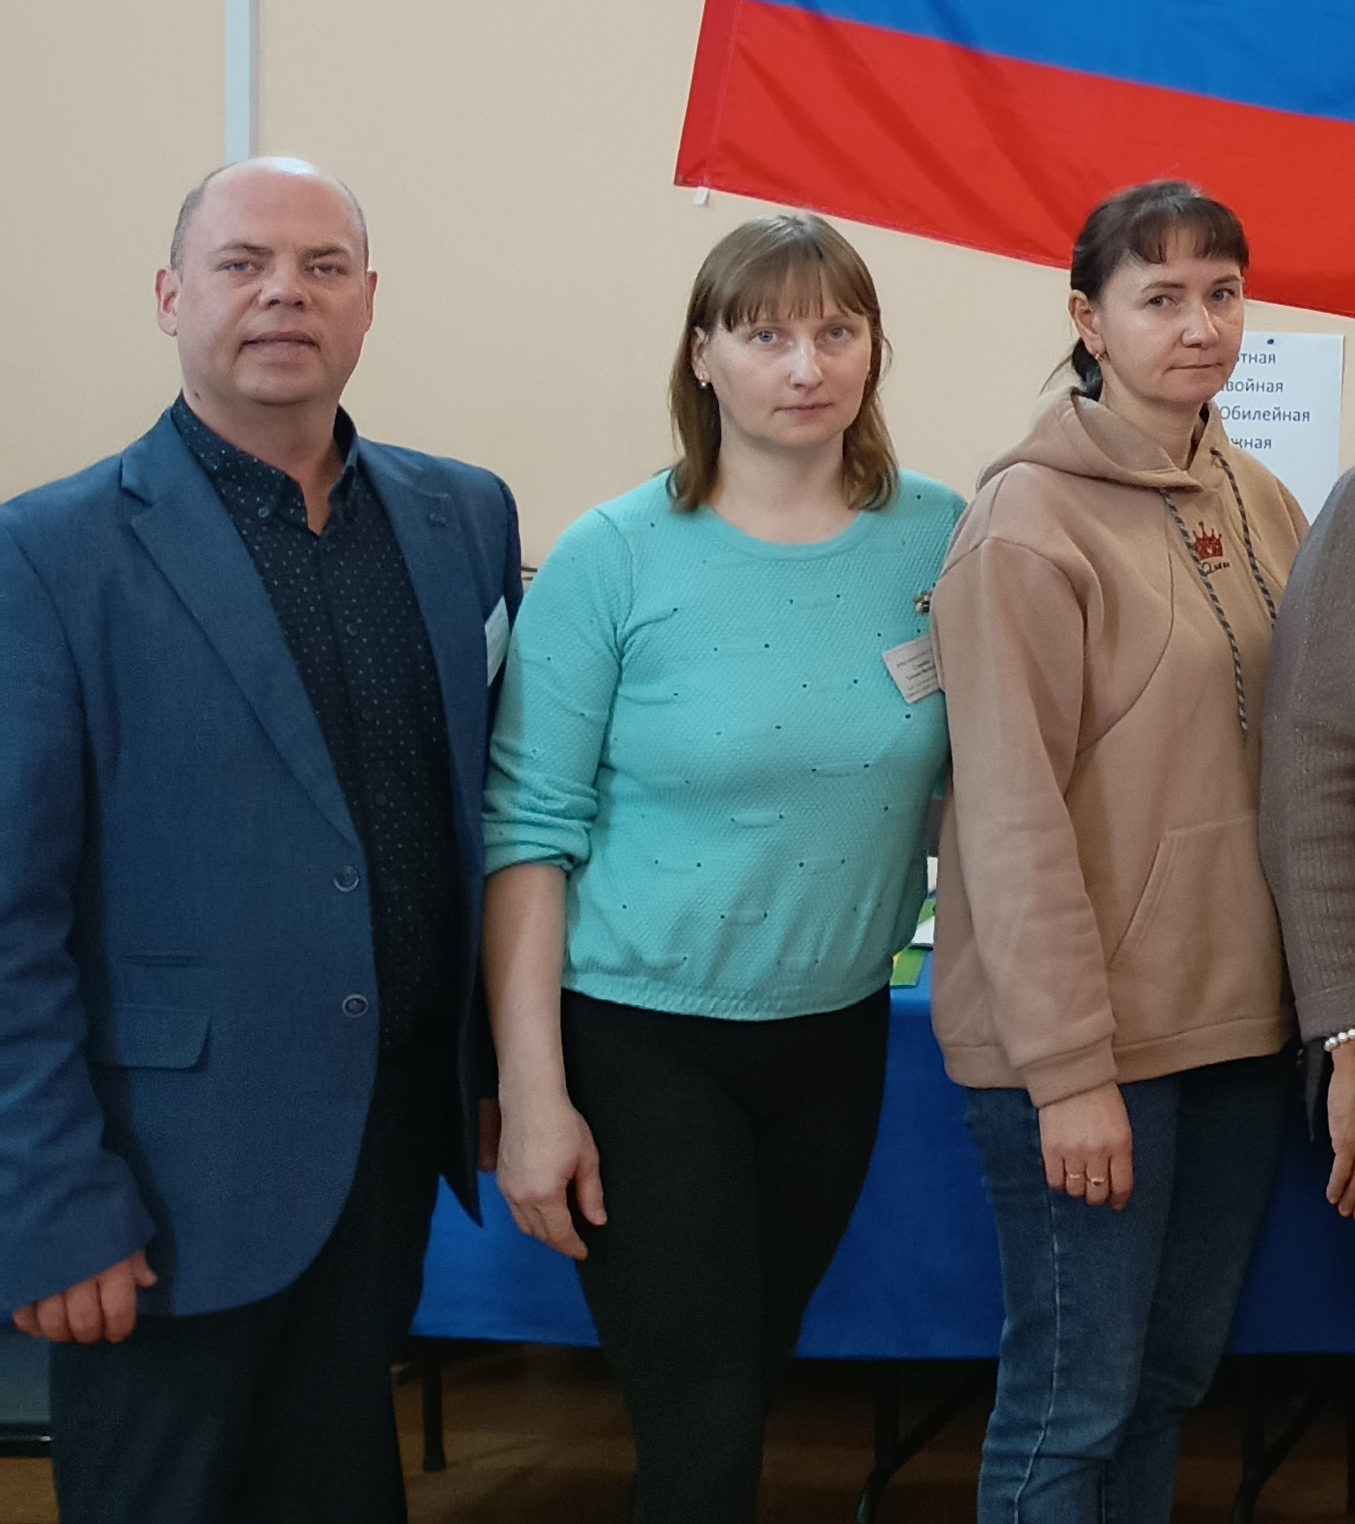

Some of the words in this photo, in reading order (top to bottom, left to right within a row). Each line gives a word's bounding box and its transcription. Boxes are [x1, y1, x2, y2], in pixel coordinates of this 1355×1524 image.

[1238, 353, 1276, 365] тная
[1222, 378, 1284, 393] войная
[1231, 437, 1272, 450] жная
